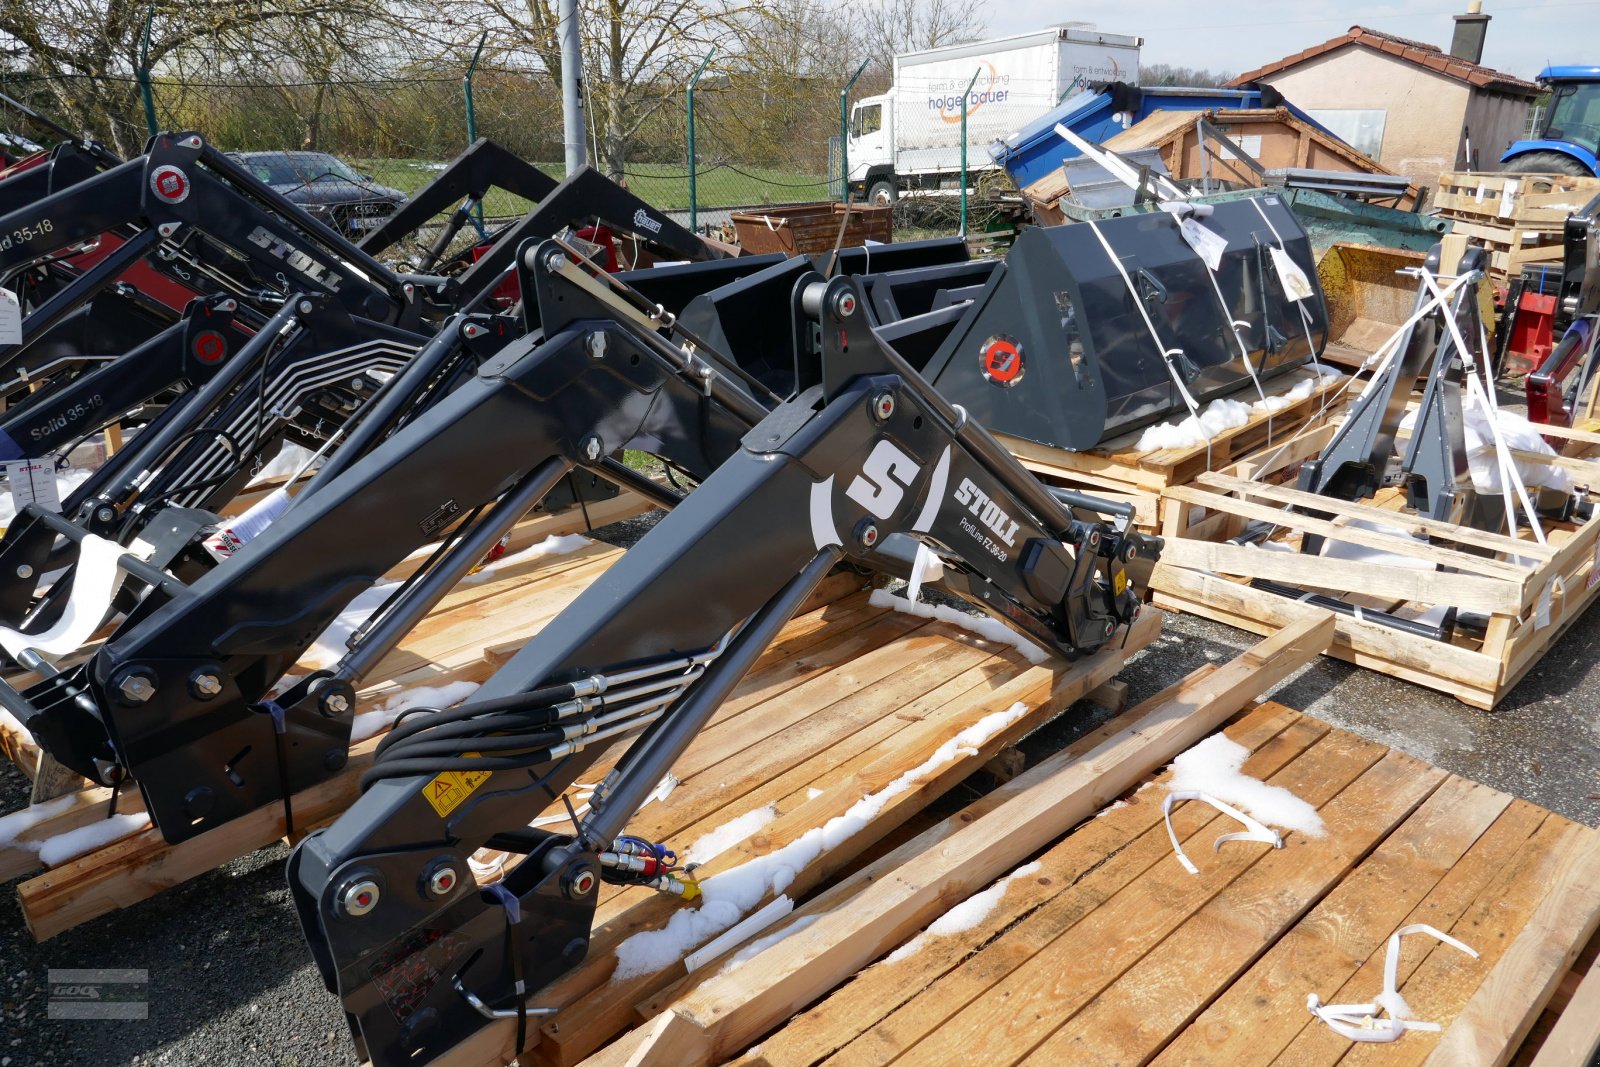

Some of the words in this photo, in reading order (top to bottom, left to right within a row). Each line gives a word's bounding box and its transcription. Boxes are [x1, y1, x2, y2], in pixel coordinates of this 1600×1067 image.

[970, 90, 1009, 105] bauer
[13, 219, 53, 244] 35-18
[247, 225, 343, 294] STOLL
[30, 413, 68, 441] Solid
[67, 394, 104, 421] 35-18
[845, 439, 921, 521] S
[953, 477, 1020, 548] STOLL
[959, 516, 984, 543] ProfiLine
[982, 536, 993, 551] FZ
